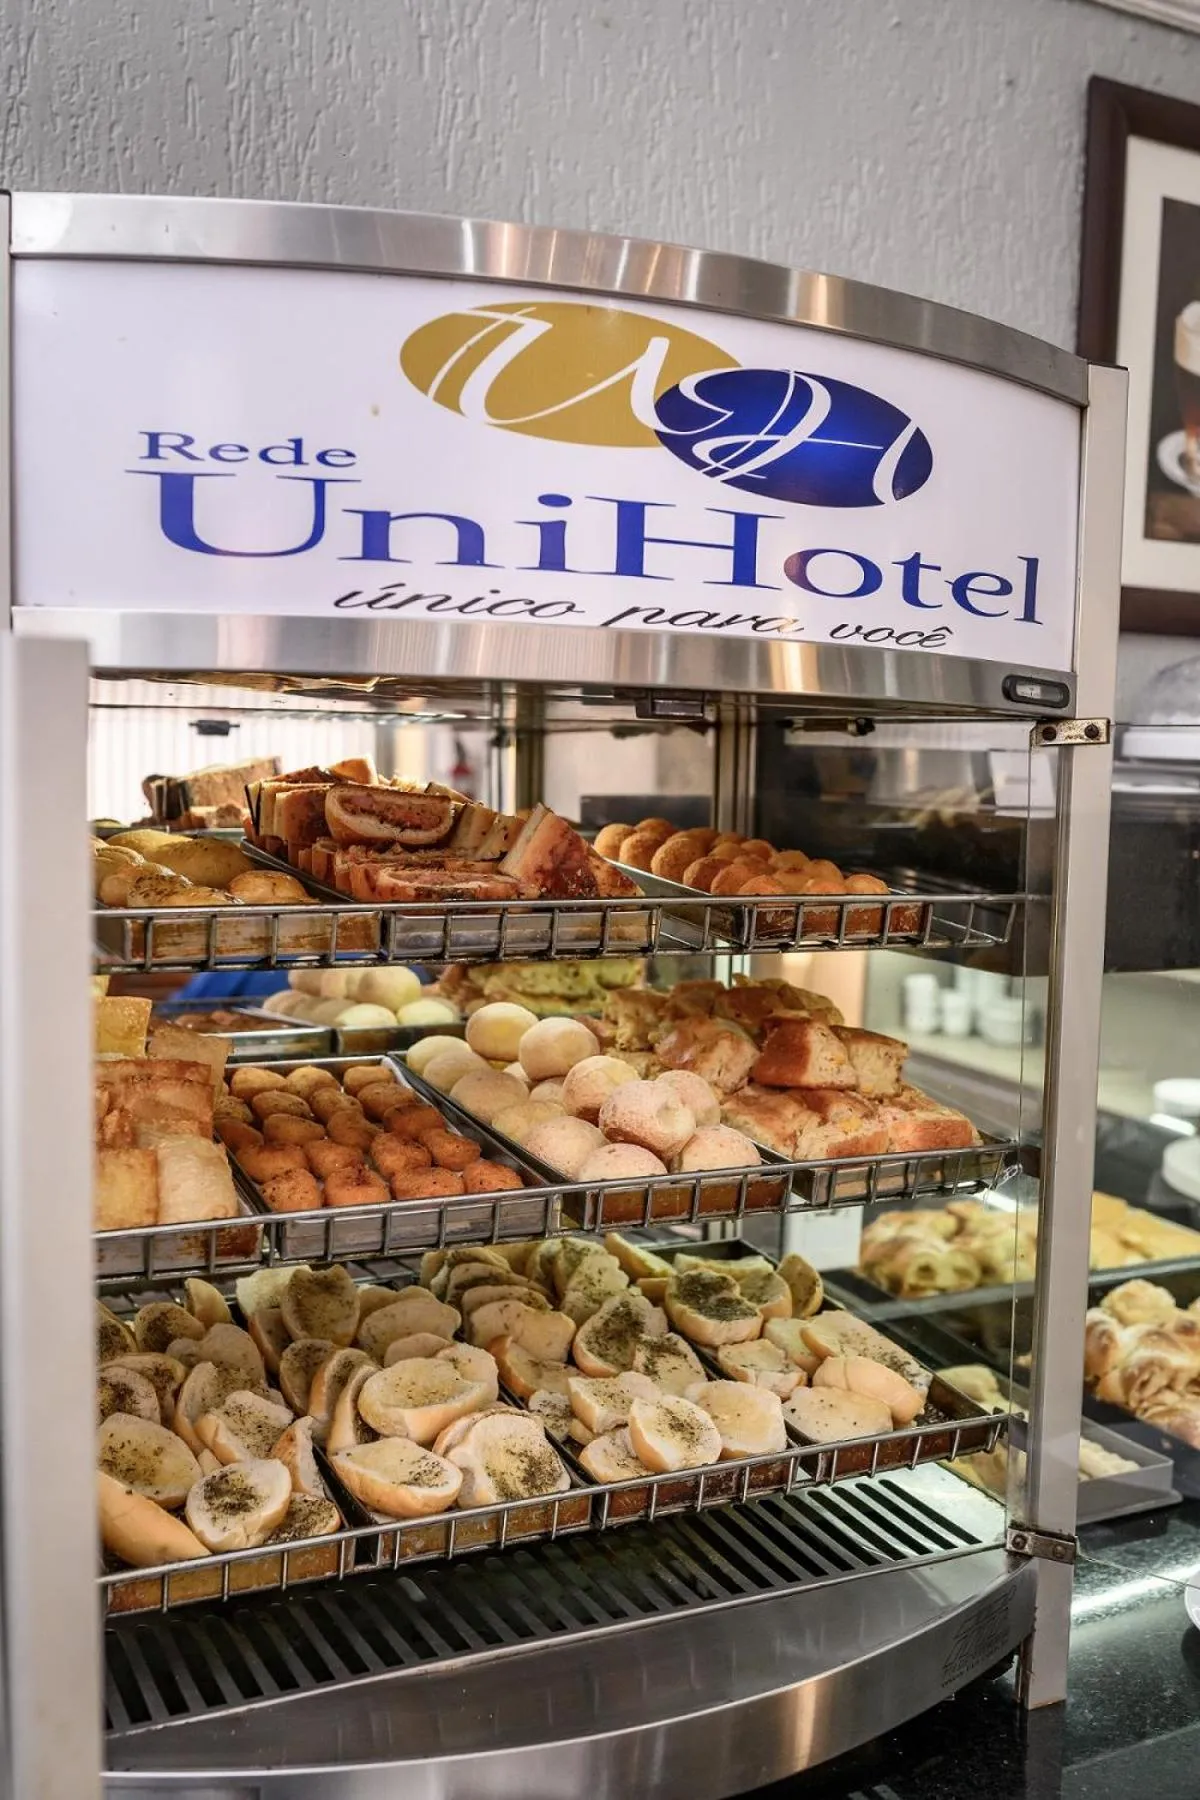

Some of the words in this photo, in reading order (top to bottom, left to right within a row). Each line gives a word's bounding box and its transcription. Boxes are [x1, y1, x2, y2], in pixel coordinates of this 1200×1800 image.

[137, 431, 357, 467] Rede
[124, 469, 1044, 625] UniHotel
[333, 582, 586, 618] único
[600, 604, 806, 632] para
[829, 624, 953, 648] você
